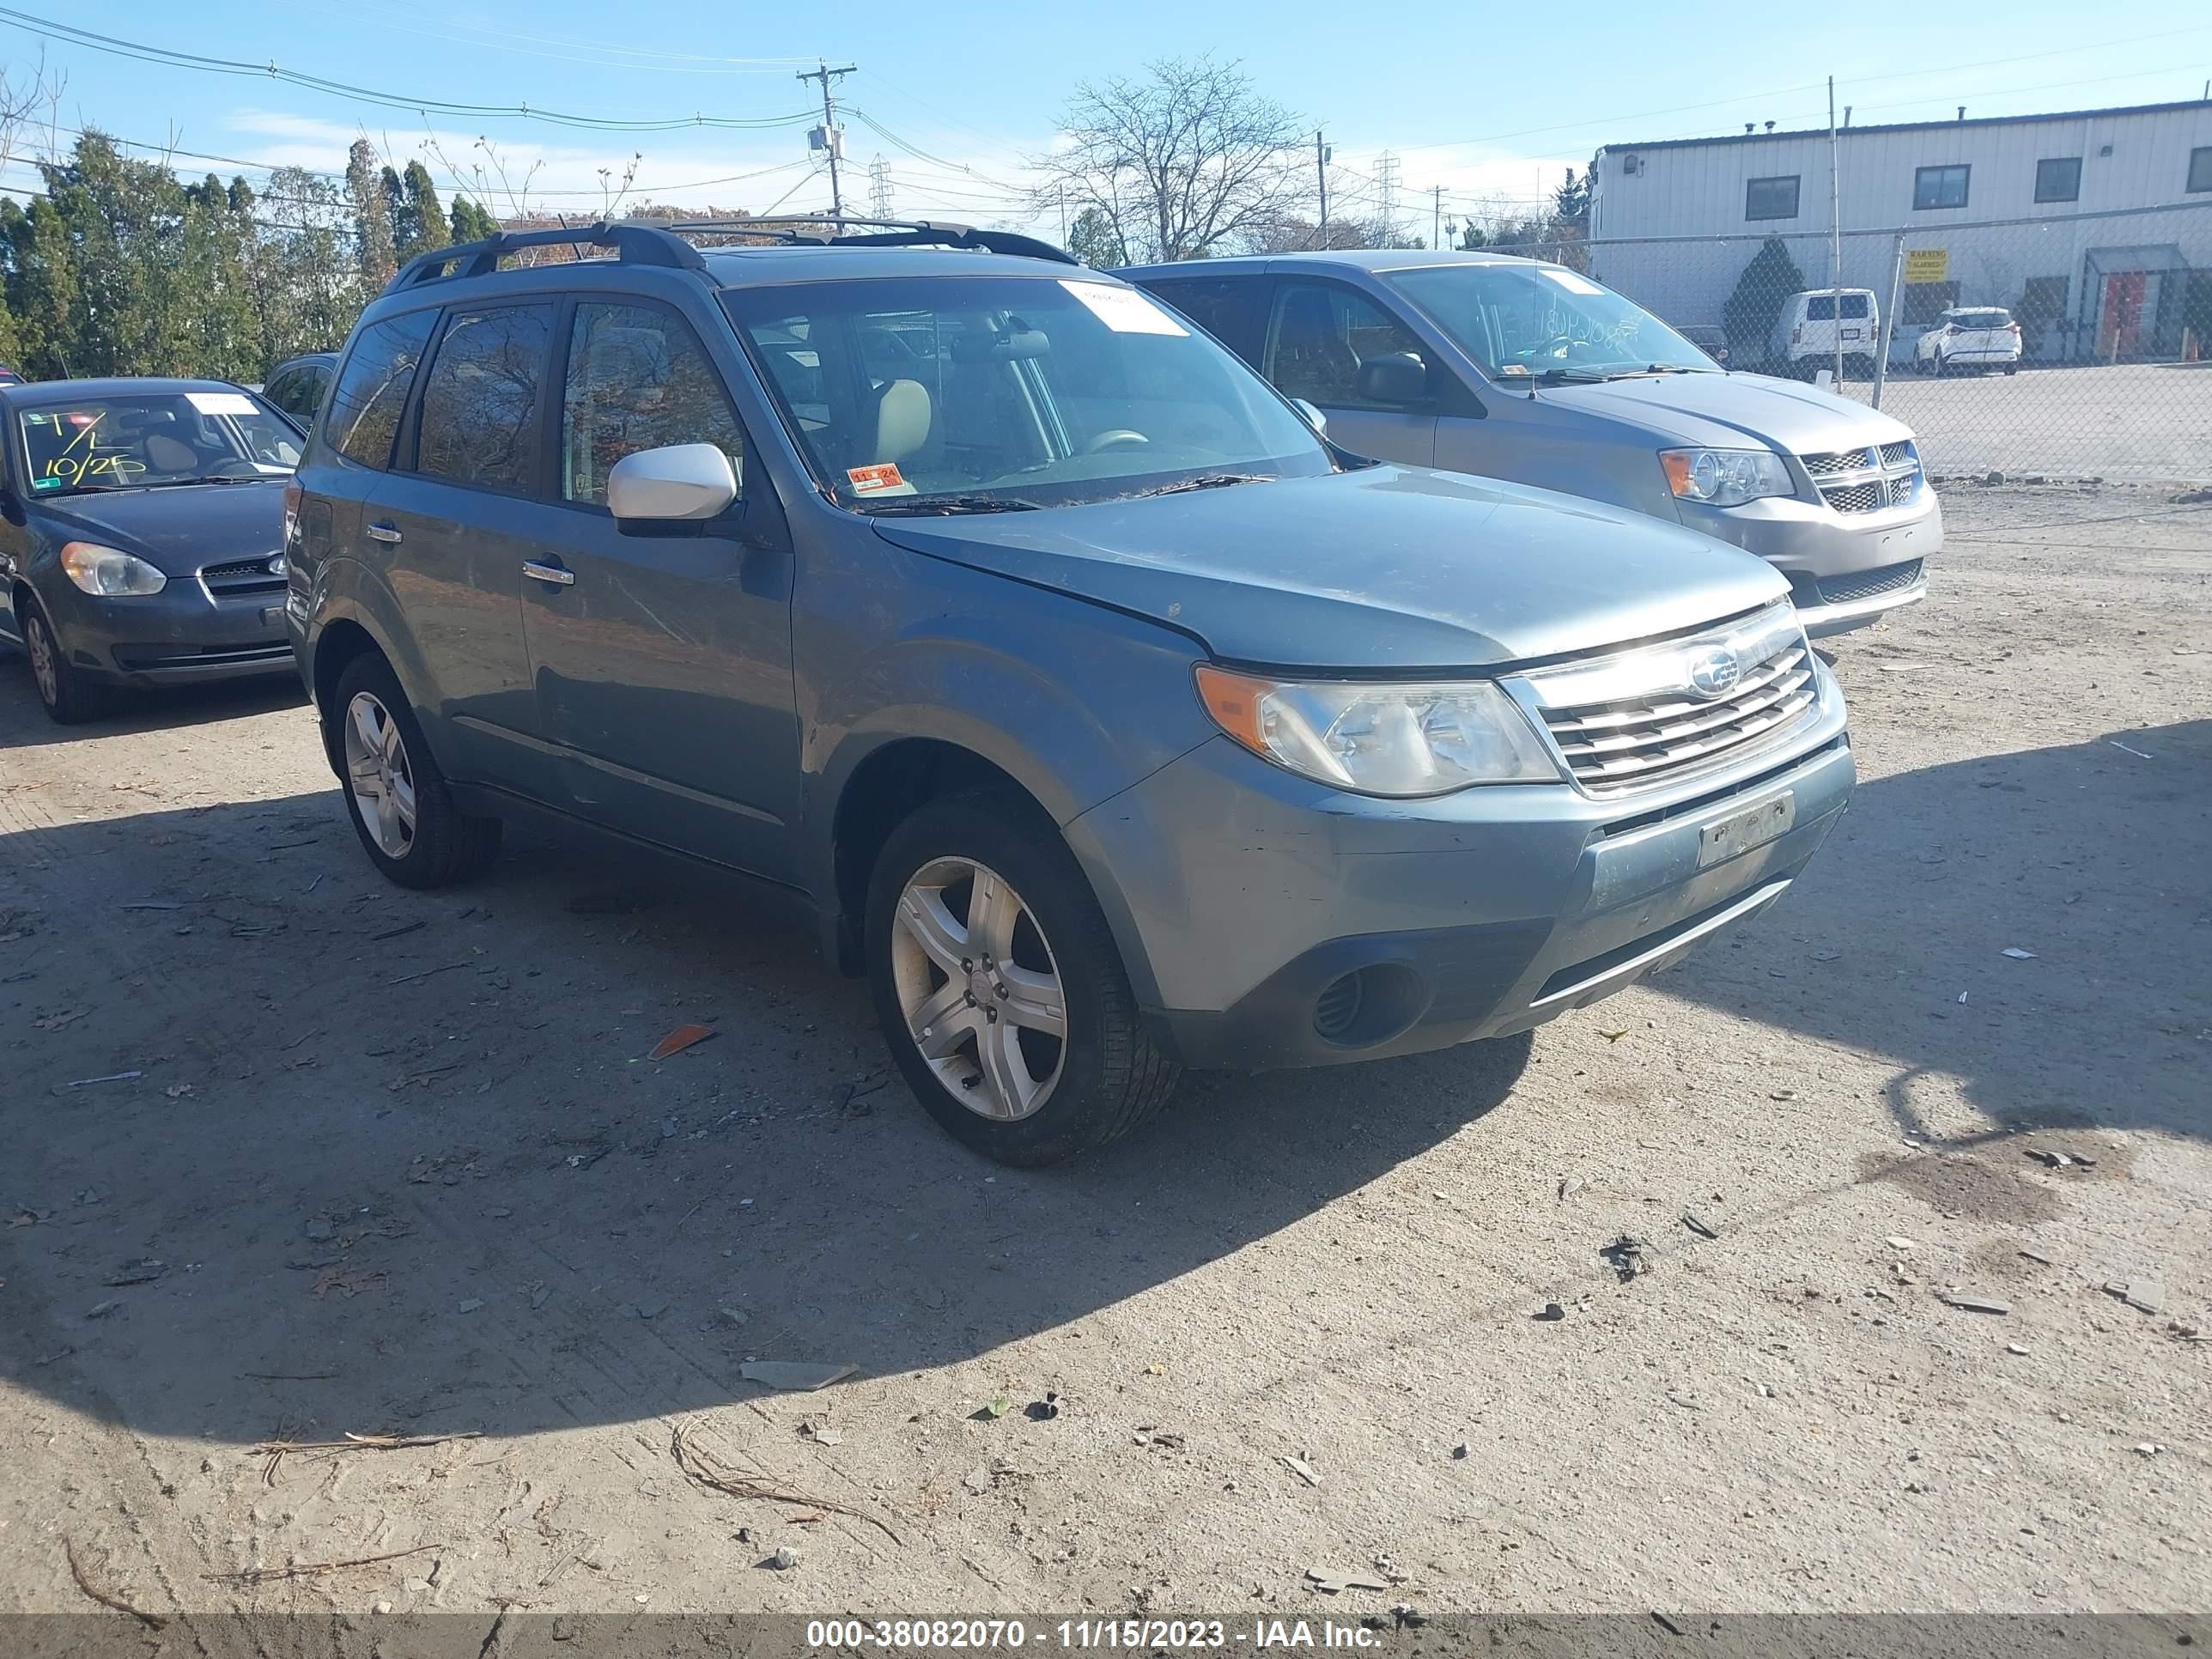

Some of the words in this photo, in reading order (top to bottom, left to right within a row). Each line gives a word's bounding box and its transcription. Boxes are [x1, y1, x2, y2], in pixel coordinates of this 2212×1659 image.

[1910, 250, 1946, 258] WARNING
[46, 452, 147, 486] 10/25
[881, 469, 896, 478] 24
